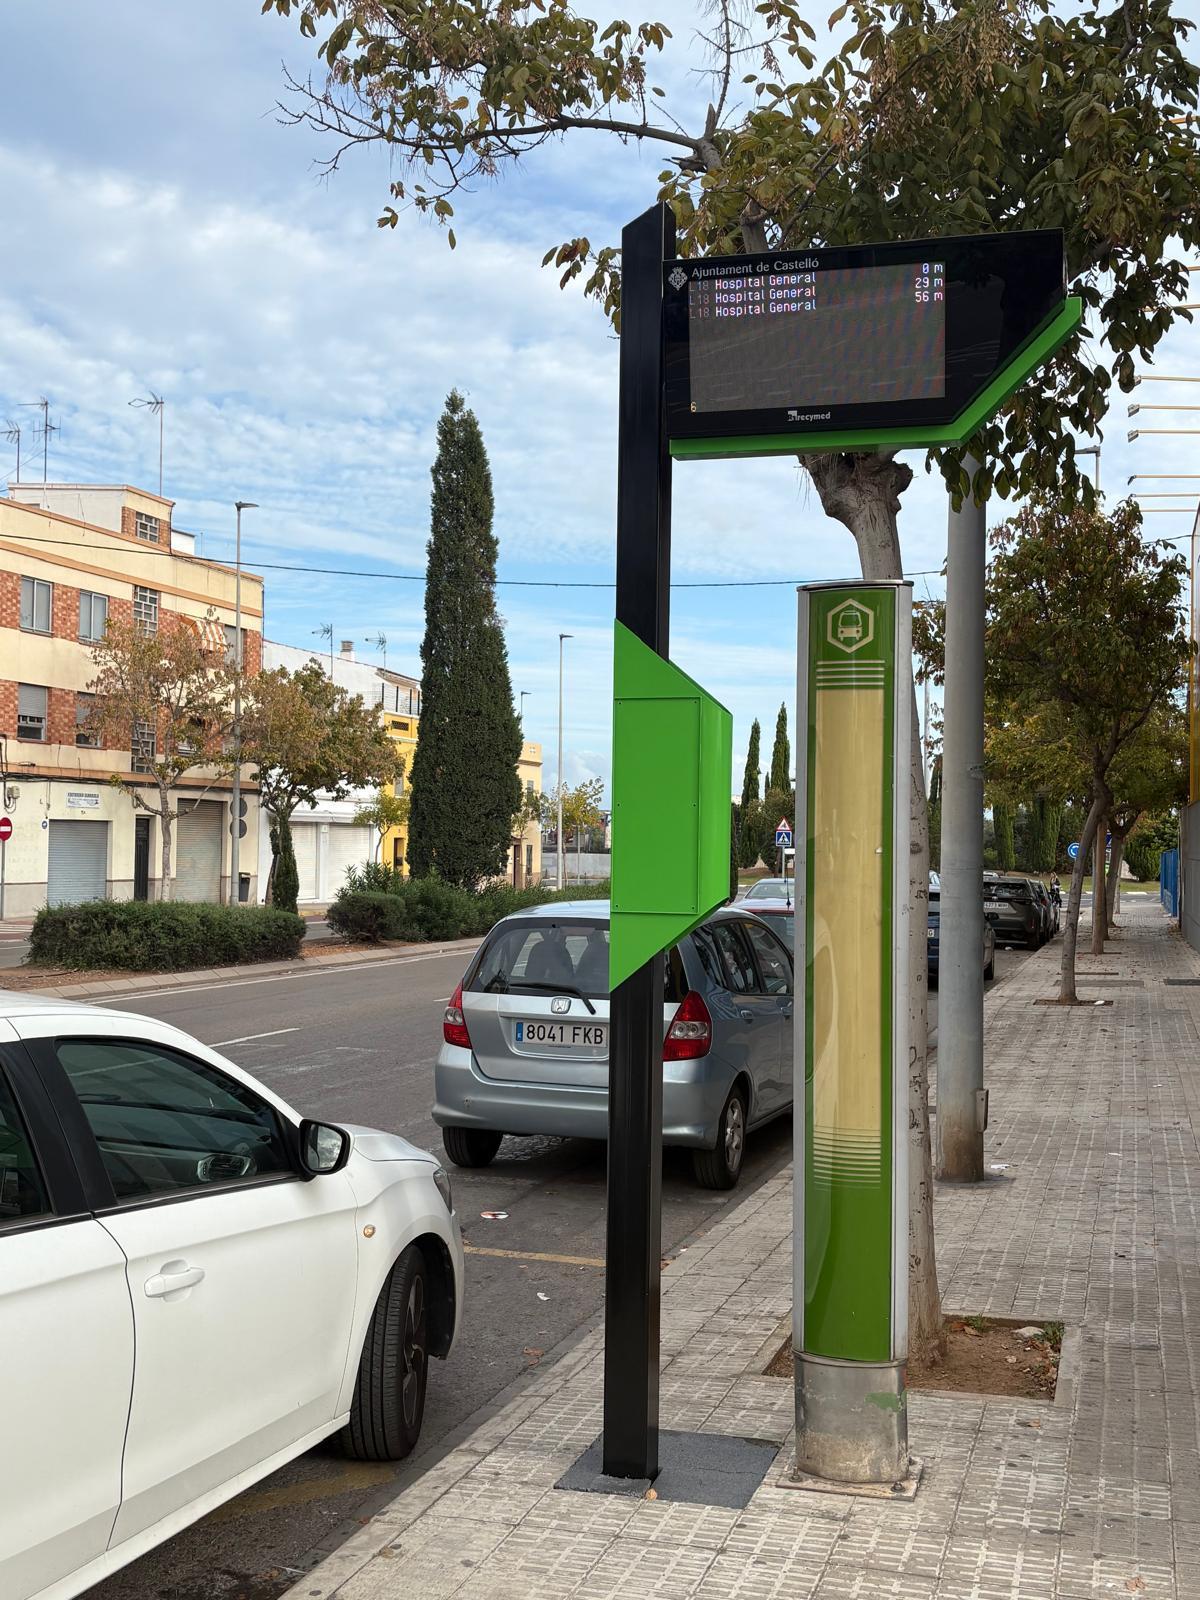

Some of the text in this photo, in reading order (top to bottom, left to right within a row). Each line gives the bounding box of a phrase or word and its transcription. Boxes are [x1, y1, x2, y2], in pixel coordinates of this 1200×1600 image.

[691, 257, 820, 280] Ajuntament de Castelló
[715, 276, 765, 290] Hospital
[769, 271, 816, 286] General
[922, 262, 930, 274] 0
[933, 263, 943, 273] m
[715, 290, 765, 304] Hospital
[769, 286, 816, 300] General
[915, 276, 930, 289] 29
[933, 277, 943, 287] m
[715, 303, 765, 317] Hospital
[769, 299, 816, 313] General
[914, 290, 930, 303] 56
[933, 291, 943, 301] m
[526, 1024, 564, 1043] 8041
[572, 1026, 604, 1045] FKB
